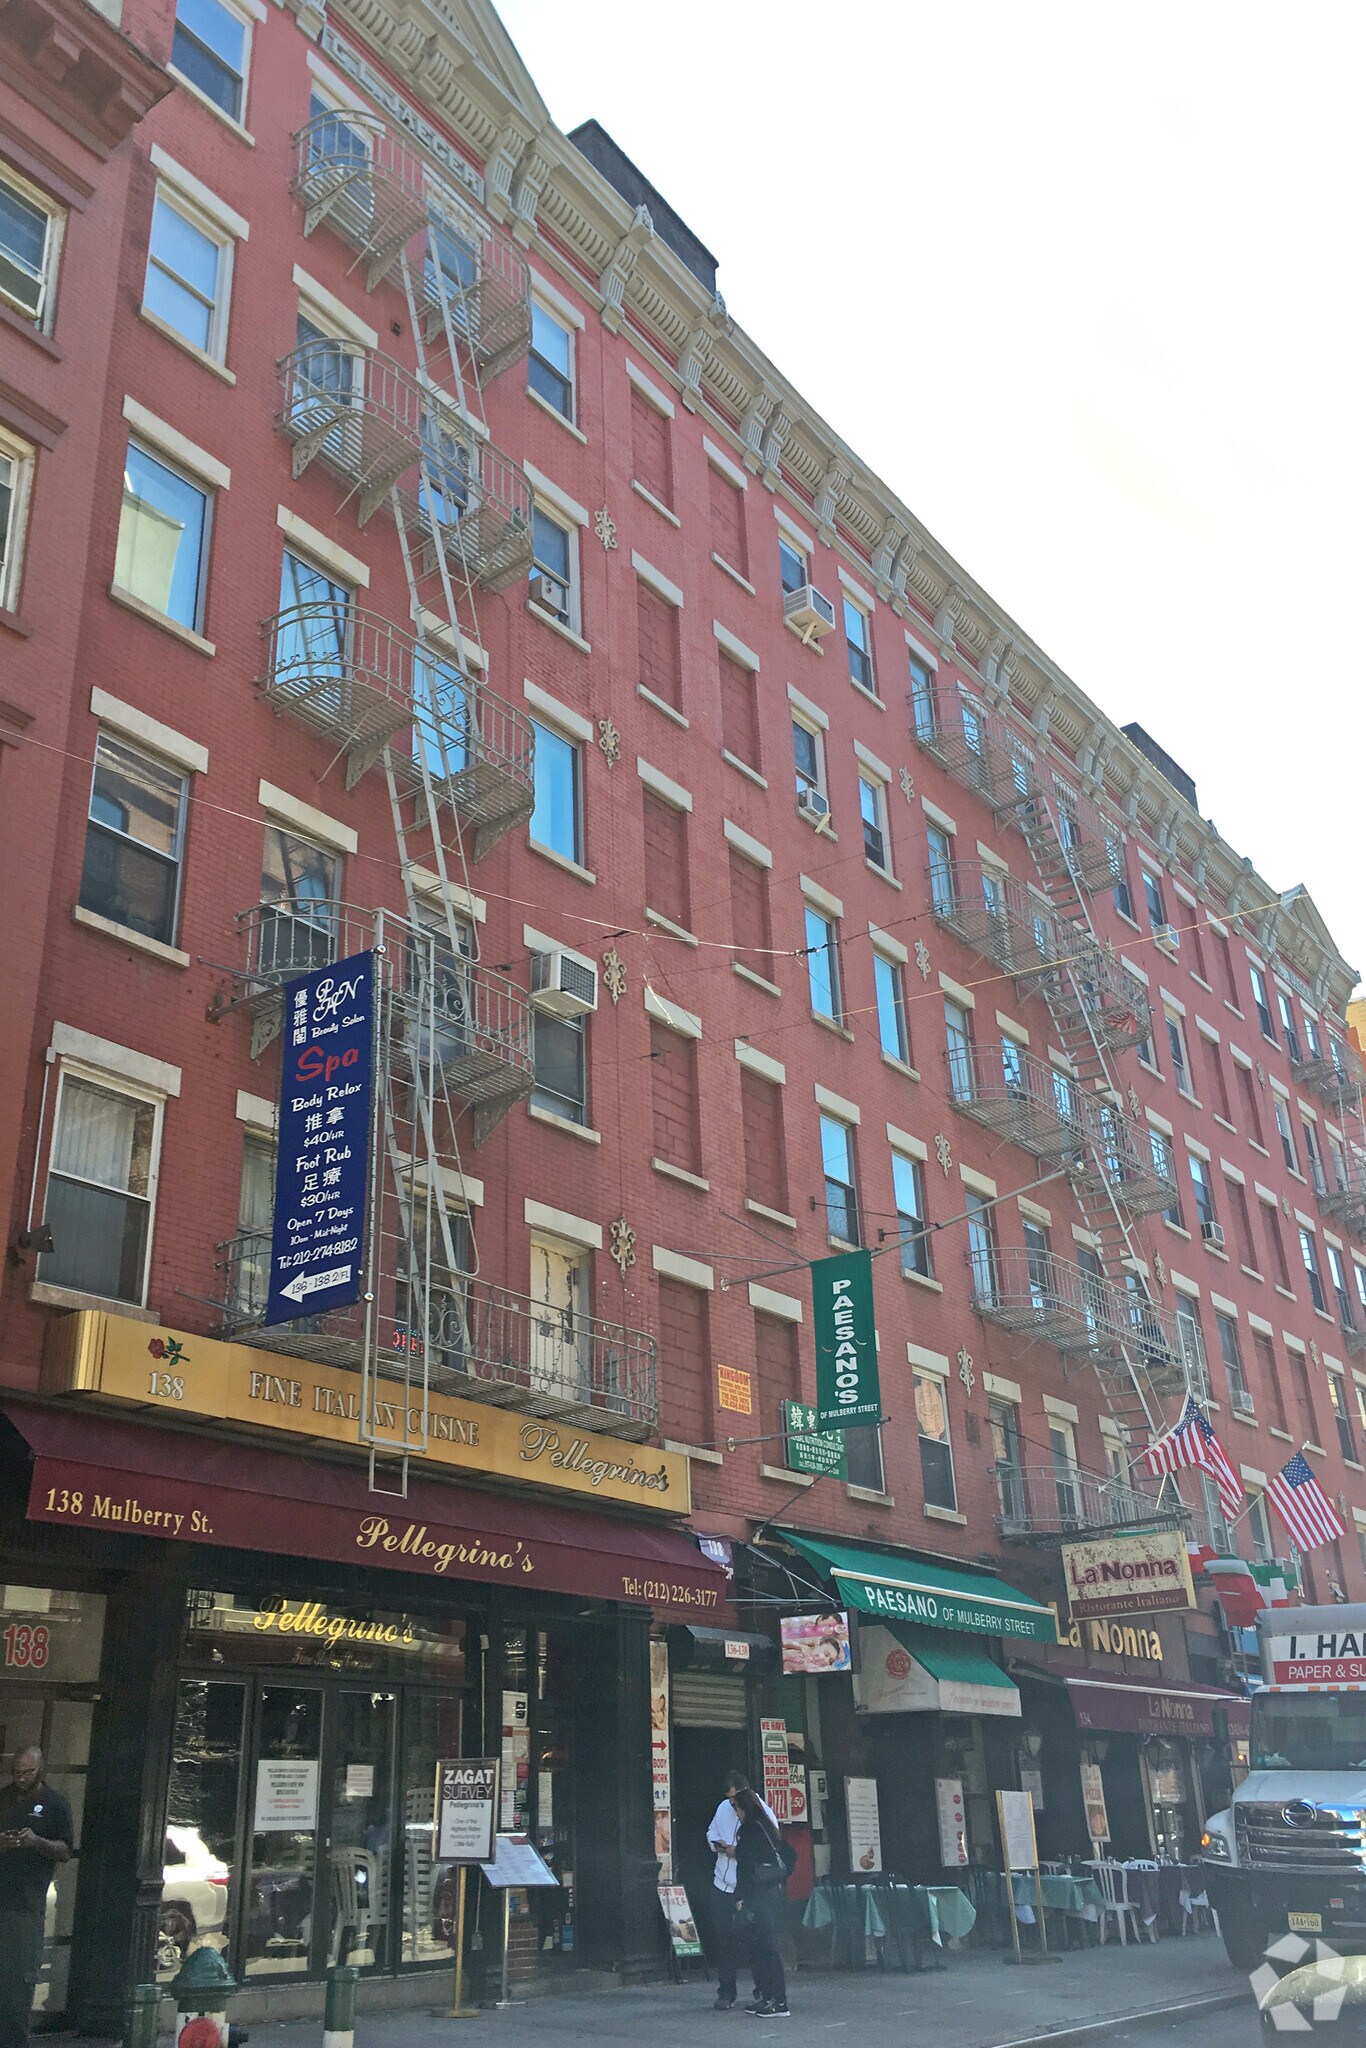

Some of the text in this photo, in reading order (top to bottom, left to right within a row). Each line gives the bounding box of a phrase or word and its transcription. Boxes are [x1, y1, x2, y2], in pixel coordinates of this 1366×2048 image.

[311, 1014, 366, 1038] Beauty Salon
[295, 1045, 359, 1082] Spa
[290, 1083, 362, 1112] Body Relax
[303, 1130, 345, 1148] $40/HR
[296, 1145, 351, 1173] Foot Rub
[300, 1190, 341, 1208] $30/HR
[287, 1207, 354, 1231] Open 7 Days
[313, 1274, 330, 1288] 138
[332, 1271, 339, 1282] 2
[340, 1270, 349, 1280] FL
[832, 1279, 859, 1404] PAESANO'S
[148, 1369, 185, 1400] 138
[249, 1371, 480, 1446] FINE ITALAN CUISINE
[820, 1403, 878, 1420] OF MULBERRY STREET
[519, 1423, 670, 1492] Pellegrino's
[45, 1488, 213, 1535] 138 Mulberry St.
[356, 1516, 535, 1573] Pellegrino's
[1071, 1559, 1178, 1585] La Nonna
[622, 1577, 718, 1607] Tel: (212) 226-3177
[1078, 1594, 1180, 1613] Ristorante Italiano
[253, 1594, 416, 1650] Pellegrino's
[864, 1586, 1035, 1635] PAESANO OF MULBERRY STREET
[1050, 1602, 1164, 1662] La Nonna
[3, 1623, 49, 1668] 138
[1290, 1633, 1366, 1659] I. HA
[1288, 1665, 1332, 1679] PAPER
[1335, 1664, 1346, 1678] &
[763, 1755, 788, 1764] THE BEST
[765, 1766, 789, 1775] BRICK
[444, 1769, 494, 1785] ZAGAT
[765, 1778, 789, 1787] OVEN
[443, 1785, 493, 1799] SURVEY
[449, 1801, 485, 1809] Pellegrino's
